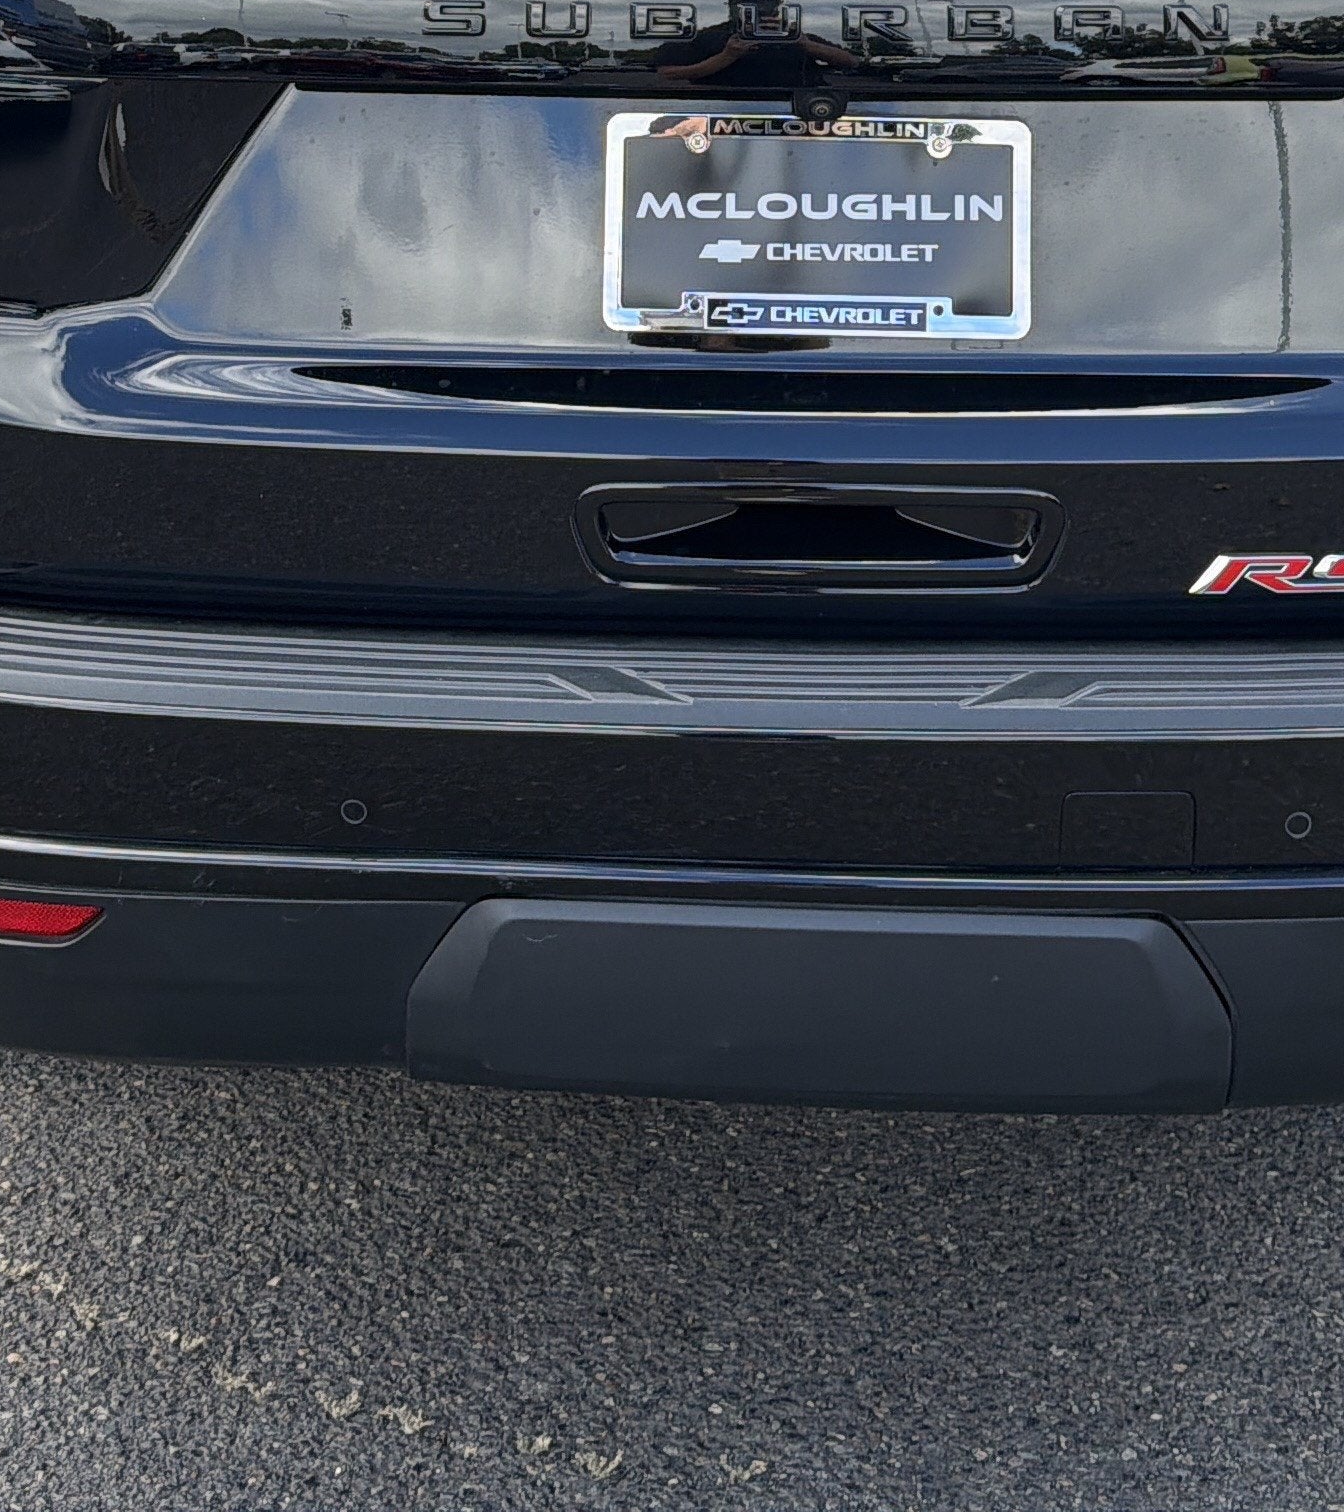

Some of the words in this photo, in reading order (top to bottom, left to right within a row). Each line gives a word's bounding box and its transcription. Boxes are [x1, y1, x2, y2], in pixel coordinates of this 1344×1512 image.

[712, 118, 926, 139] MCLOUGHLIN
[634, 190, 1004, 222] MCLOUGHLIN
[765, 242, 940, 263] CHEVROLET
[769, 304, 925, 326] CHEVROLET
